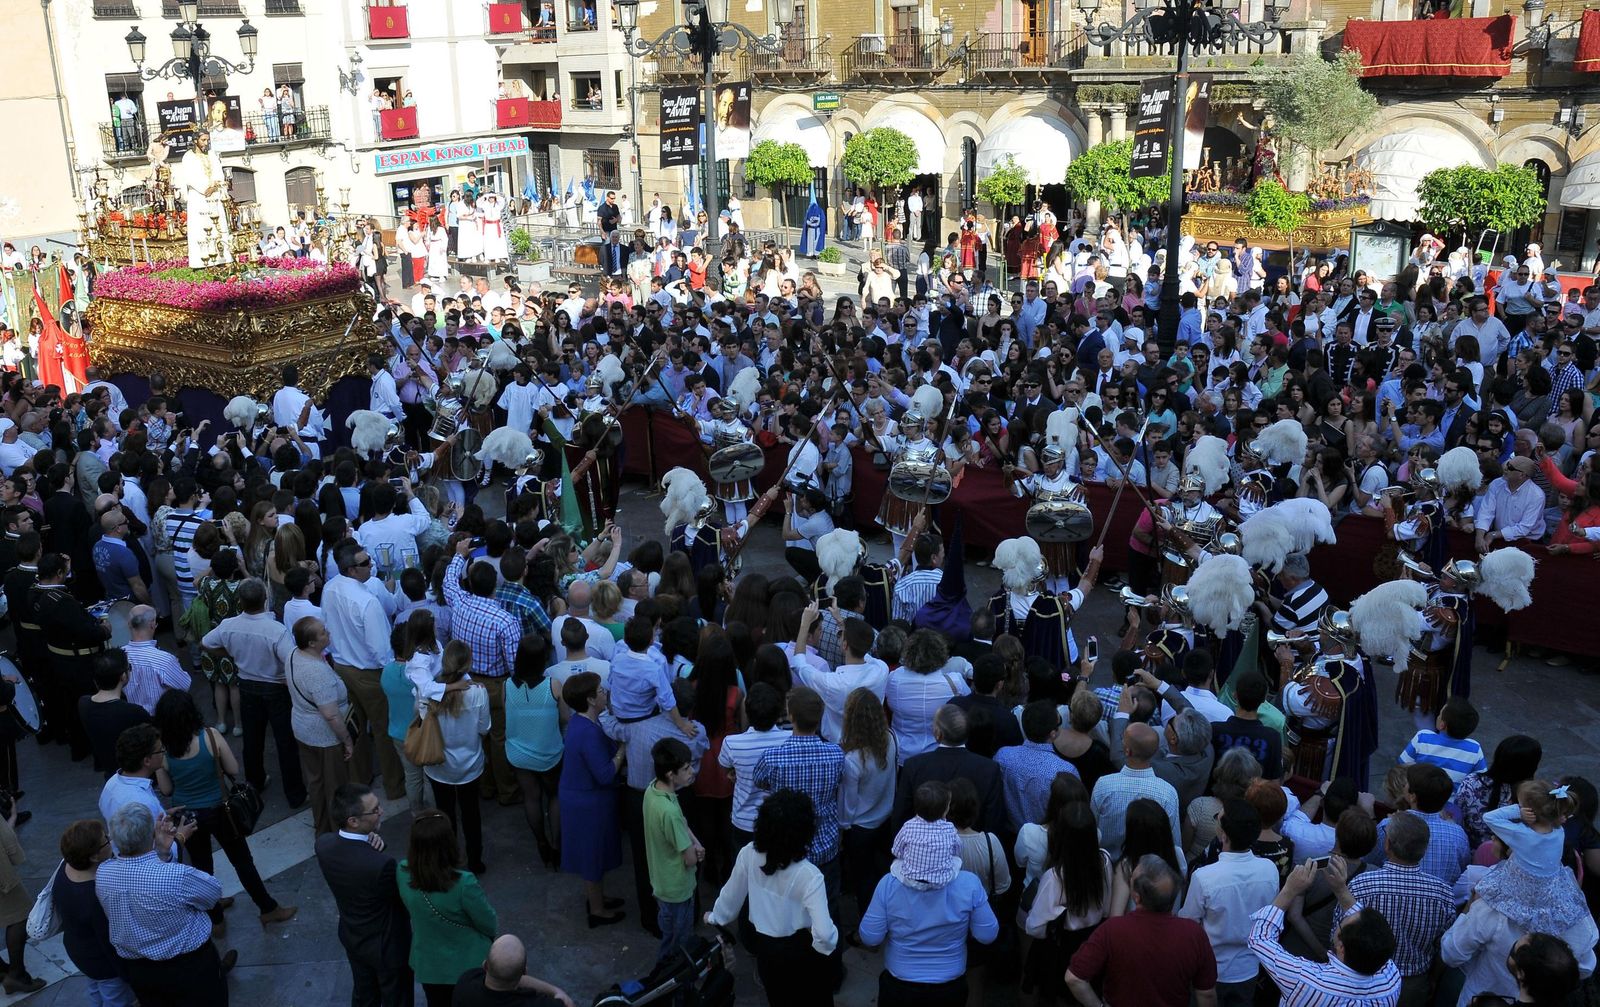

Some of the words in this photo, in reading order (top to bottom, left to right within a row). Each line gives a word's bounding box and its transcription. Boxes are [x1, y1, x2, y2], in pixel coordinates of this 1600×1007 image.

[662, 98, 675, 107] San
[673, 95, 696, 108] Juan
[1140, 92, 1152, 103] San
[1150, 89, 1169, 105] Juan
[172, 106, 192, 115] Juan
[380, 151, 431, 167] ESPAK
[436, 144, 473, 160] KING
